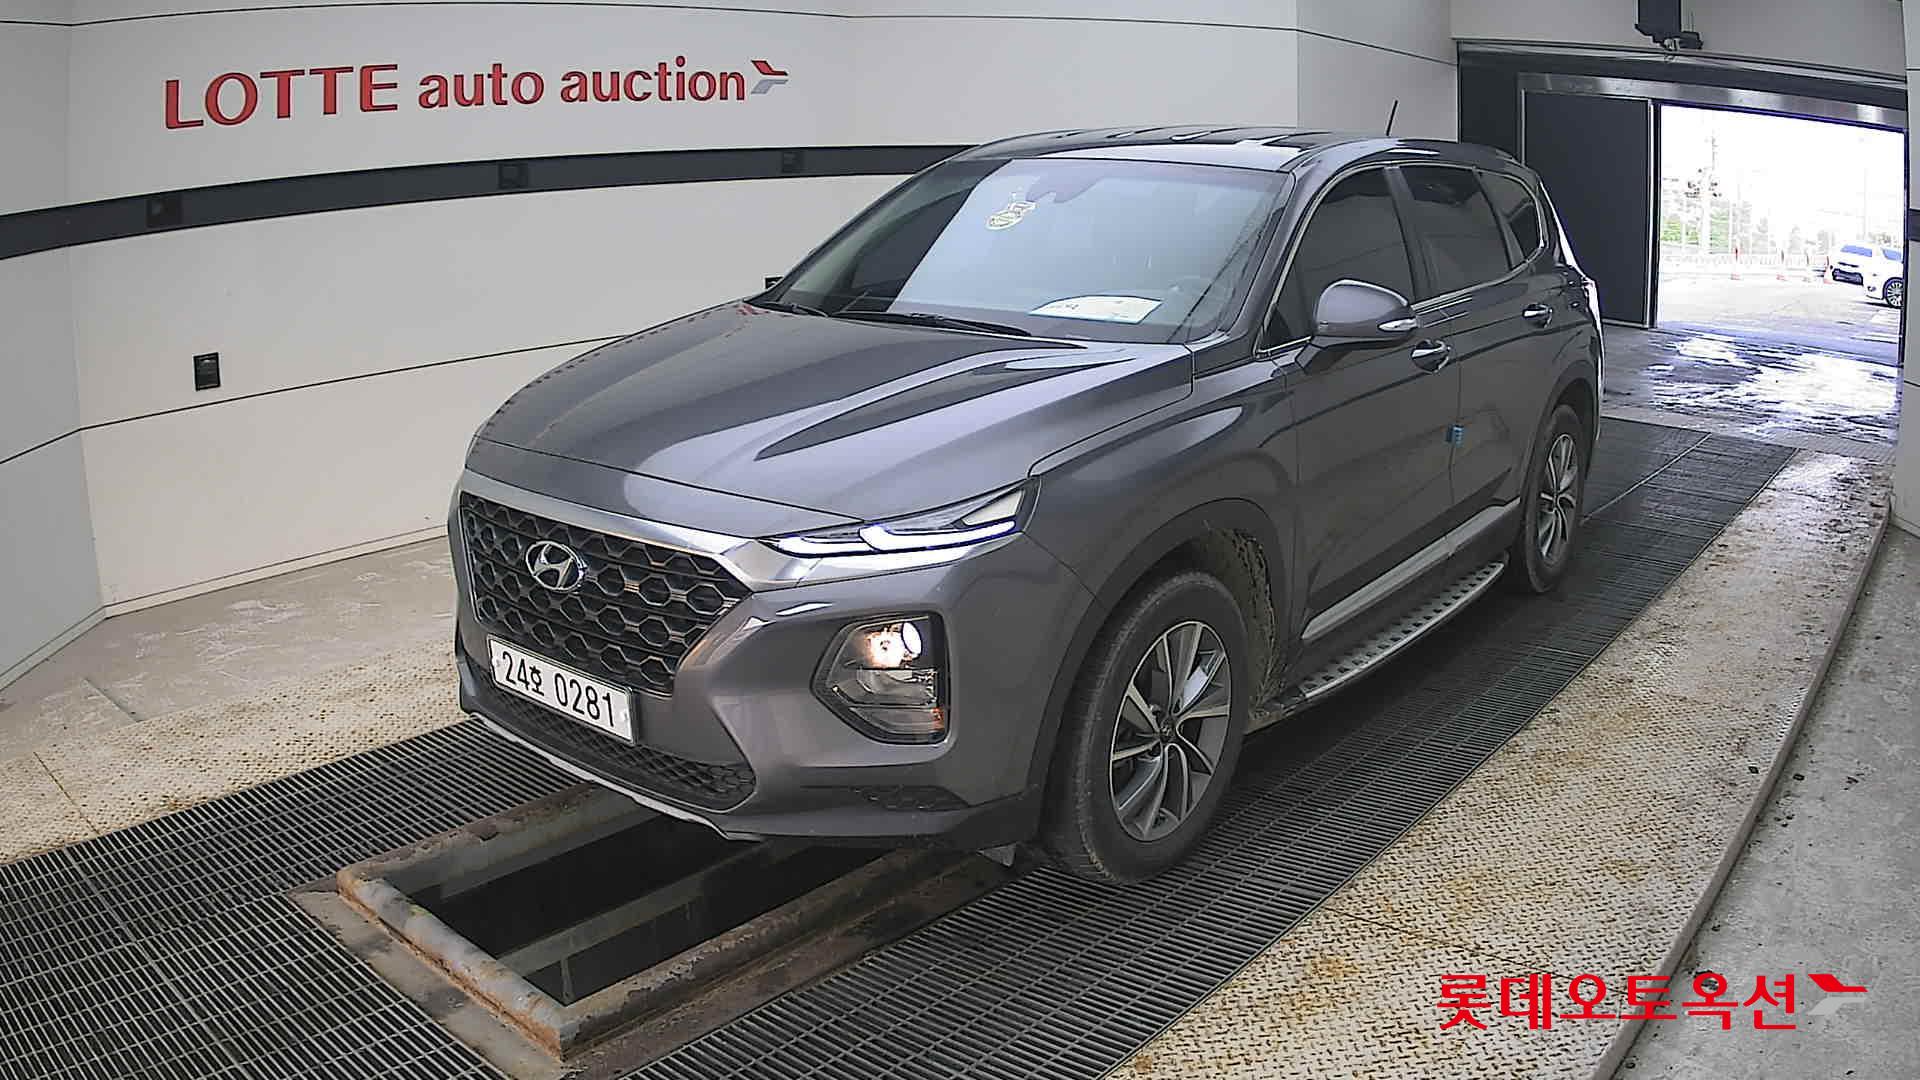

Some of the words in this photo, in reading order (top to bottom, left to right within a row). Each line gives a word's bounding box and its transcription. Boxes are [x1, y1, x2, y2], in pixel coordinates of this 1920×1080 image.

[164, 63, 400, 130] LOTTE
[417, 62, 545, 109] auto
[559, 56, 747, 105] auction
[502, 650, 545, 697] 24호
[554, 672, 615, 728] 0281
